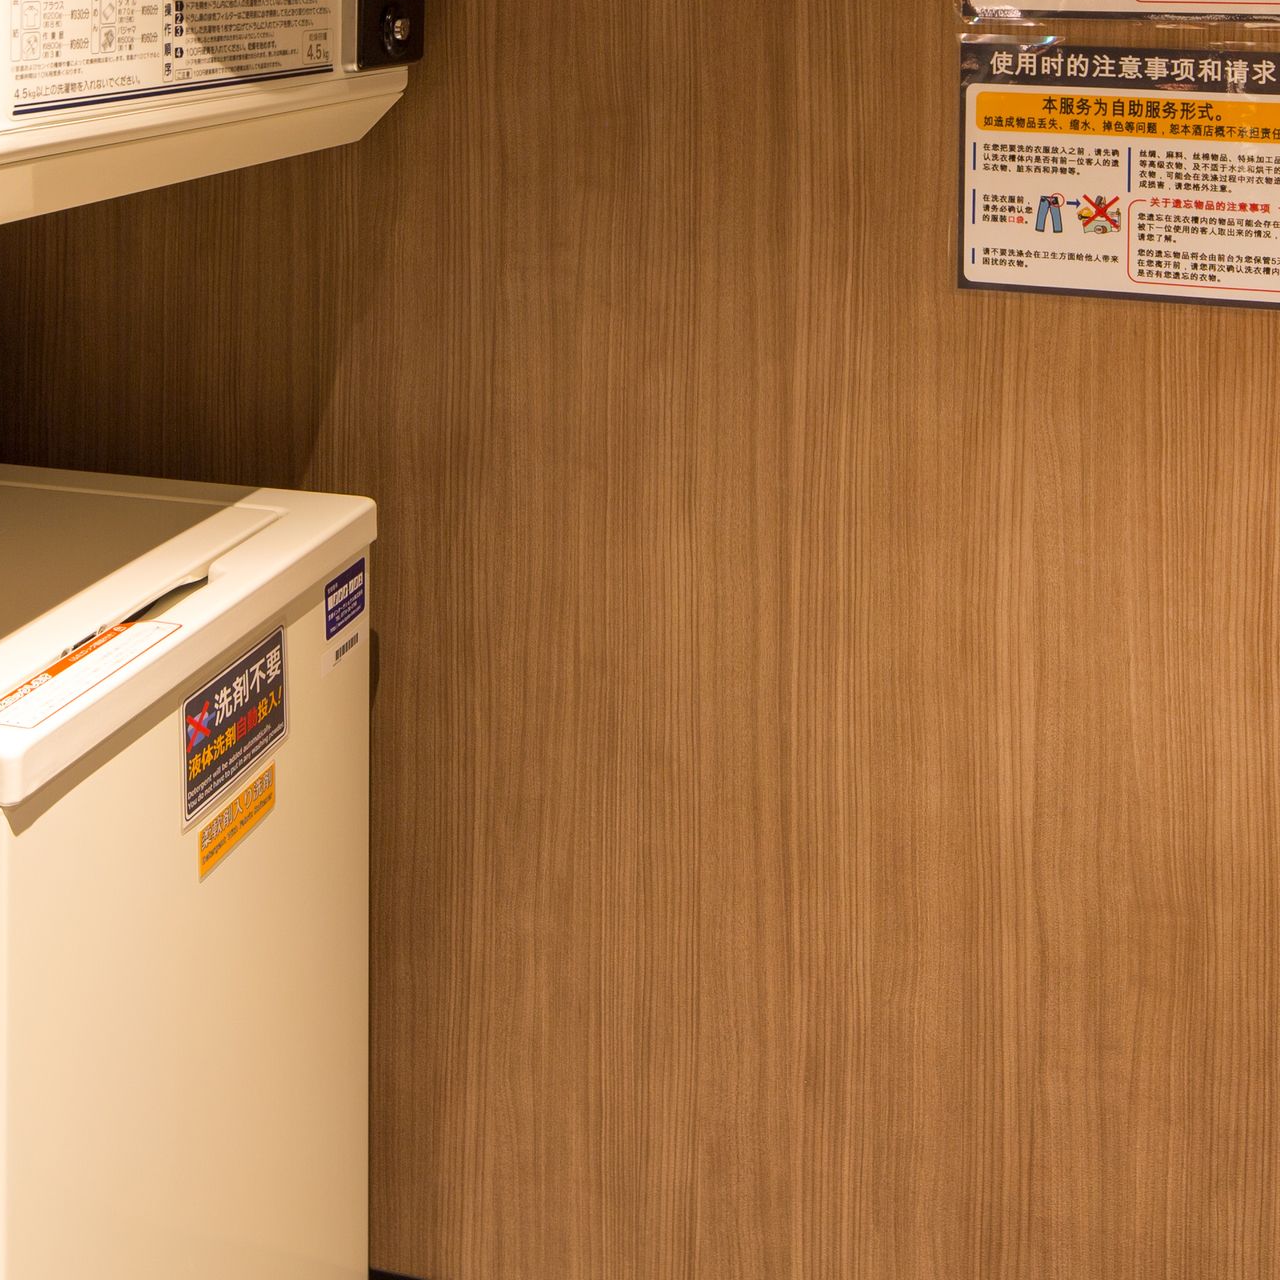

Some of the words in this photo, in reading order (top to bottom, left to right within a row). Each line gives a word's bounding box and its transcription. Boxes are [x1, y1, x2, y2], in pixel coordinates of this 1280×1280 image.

[306, 44, 322, 60] 4.5
[990, 50, 1277, 85] 使用时的注意事项和请求
[1042, 97, 1222, 122] 本服务为自助服务形式。
[983, 204, 1033, 214] 请务必确认您
[1150, 197, 1270, 214] 关于遗忘物品的注意事项
[982, 214, 1028, 224] 的服装口袋。
[1138, 234, 1177, 243] 请您了解。
[982, 257, 1028, 268] 困扰的衣物。
[214, 644, 281, 726] 洗剤不要
[188, 686, 283, 781] 液体洗剤自動投入!
